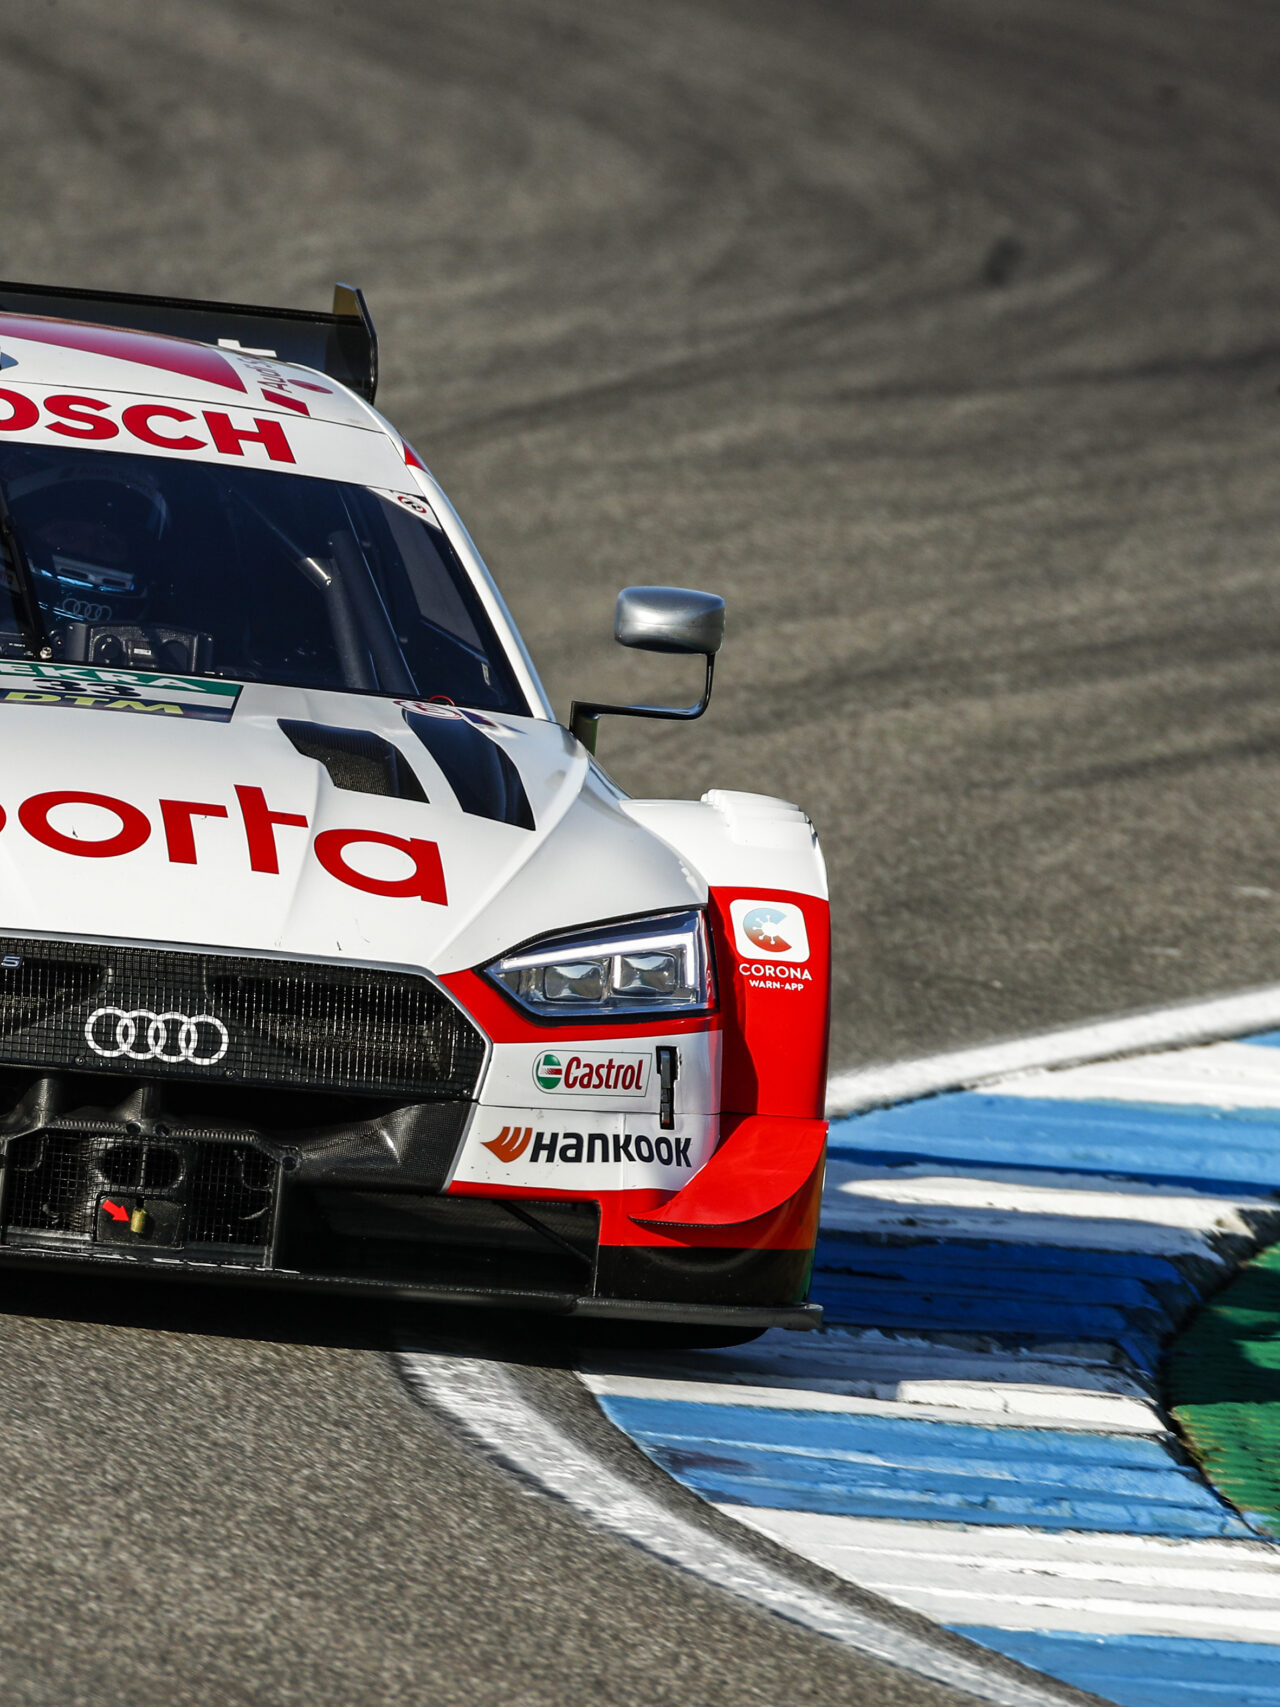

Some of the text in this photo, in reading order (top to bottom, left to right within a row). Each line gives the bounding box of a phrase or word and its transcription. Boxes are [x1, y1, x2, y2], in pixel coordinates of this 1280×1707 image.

[32, 678, 143, 698] 33
[4, 691, 185, 715] DTM
[1, 955, 20, 967] 5
[738, 963, 813, 981] CORONA
[748, 979, 804, 992] WARN-APP
[564, 1056, 643, 1090] Castrol
